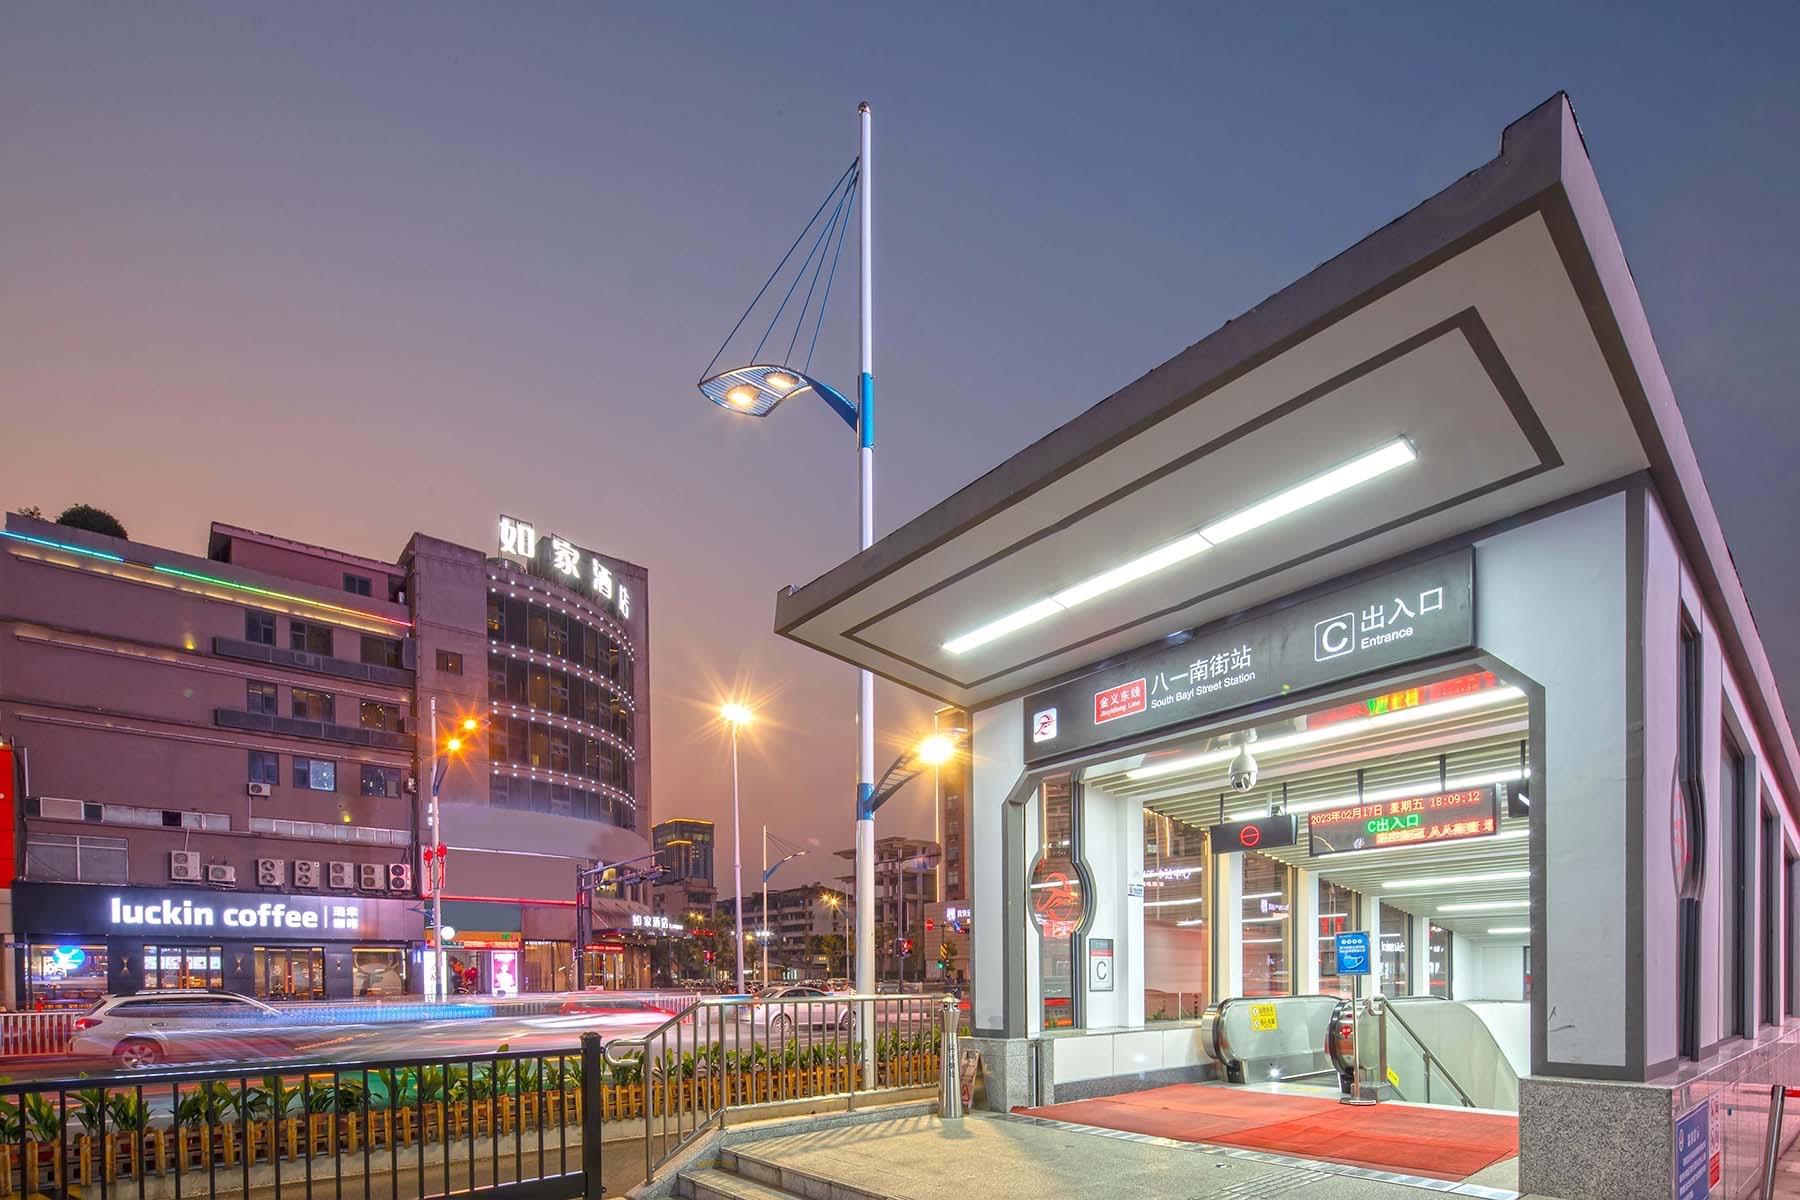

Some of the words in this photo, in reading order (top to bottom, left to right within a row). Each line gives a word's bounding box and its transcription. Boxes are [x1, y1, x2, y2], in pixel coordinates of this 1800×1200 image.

[500, 516, 629, 619] 如家酒店
[1322, 621, 1348, 653] C
[1360, 586, 1443, 632] 出入口
[1360, 626, 1414, 650] Entrance
[1151, 644, 1252, 695] 八一南街站
[1099, 685, 1141, 709] 金义东线
[1151, 694, 1174, 709] South
[1196, 679, 1222, 696] Street
[1223, 671, 1256, 688] Station
[1311, 804, 1383, 825] 2023年02月17日
[1390, 797, 1425, 814] 星期五
[1431, 791, 1481, 808] 18:09:12
[1367, 814, 1419, 832] C出入口
[111, 897, 214, 926] luckin
[223, 903, 319, 928] coffee
[1096, 961, 1107, 980] C
